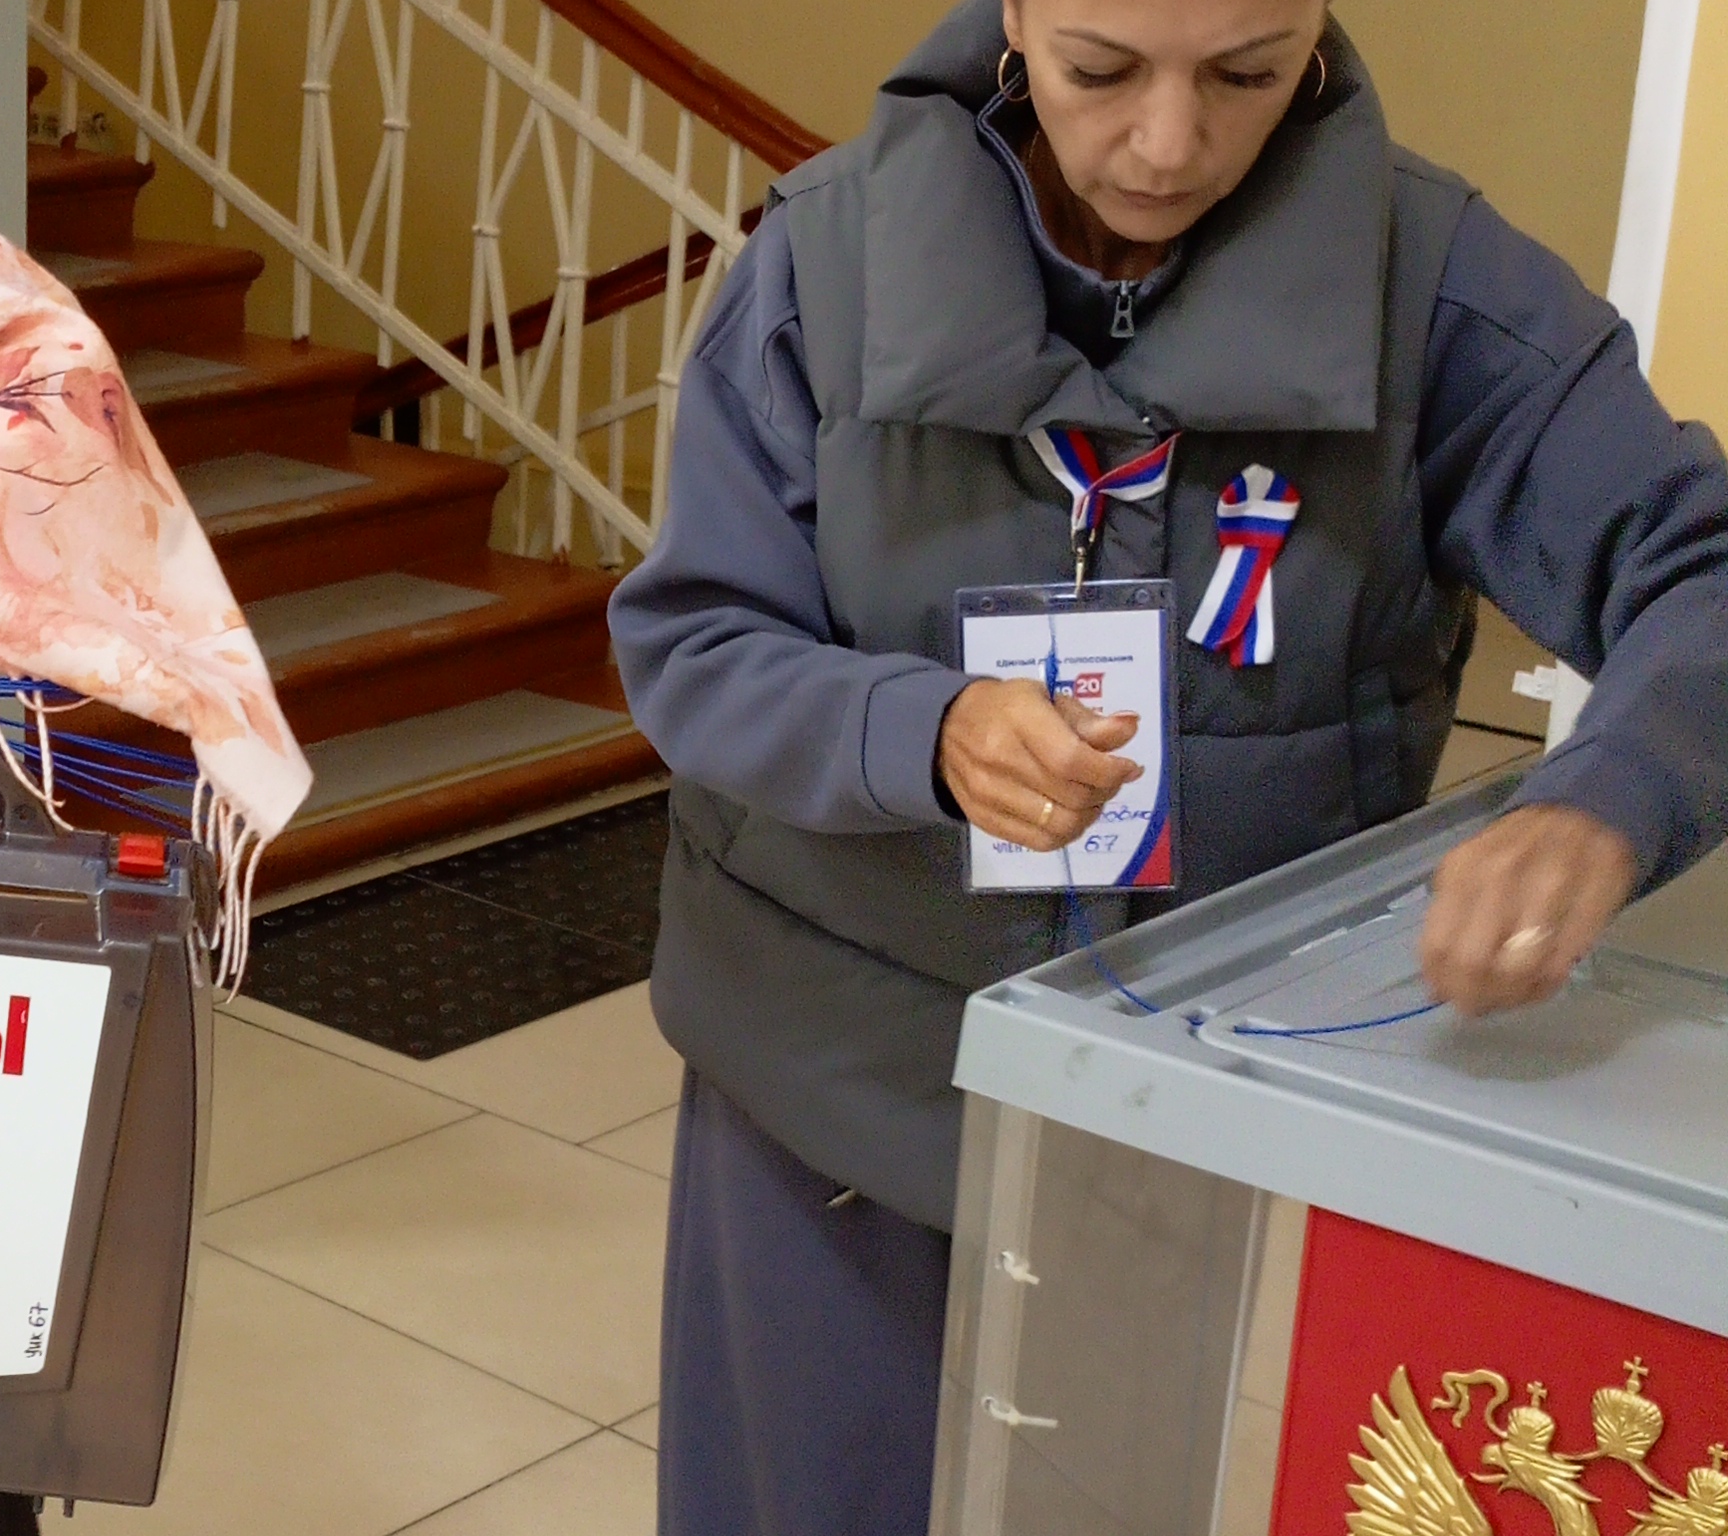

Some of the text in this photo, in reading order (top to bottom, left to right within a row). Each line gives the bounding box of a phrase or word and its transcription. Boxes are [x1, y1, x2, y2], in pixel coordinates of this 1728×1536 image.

[1076, 678, 1100, 693] 20
[1084, 834, 1119, 853] 67
[28, 1301, 49, 1328] 67
